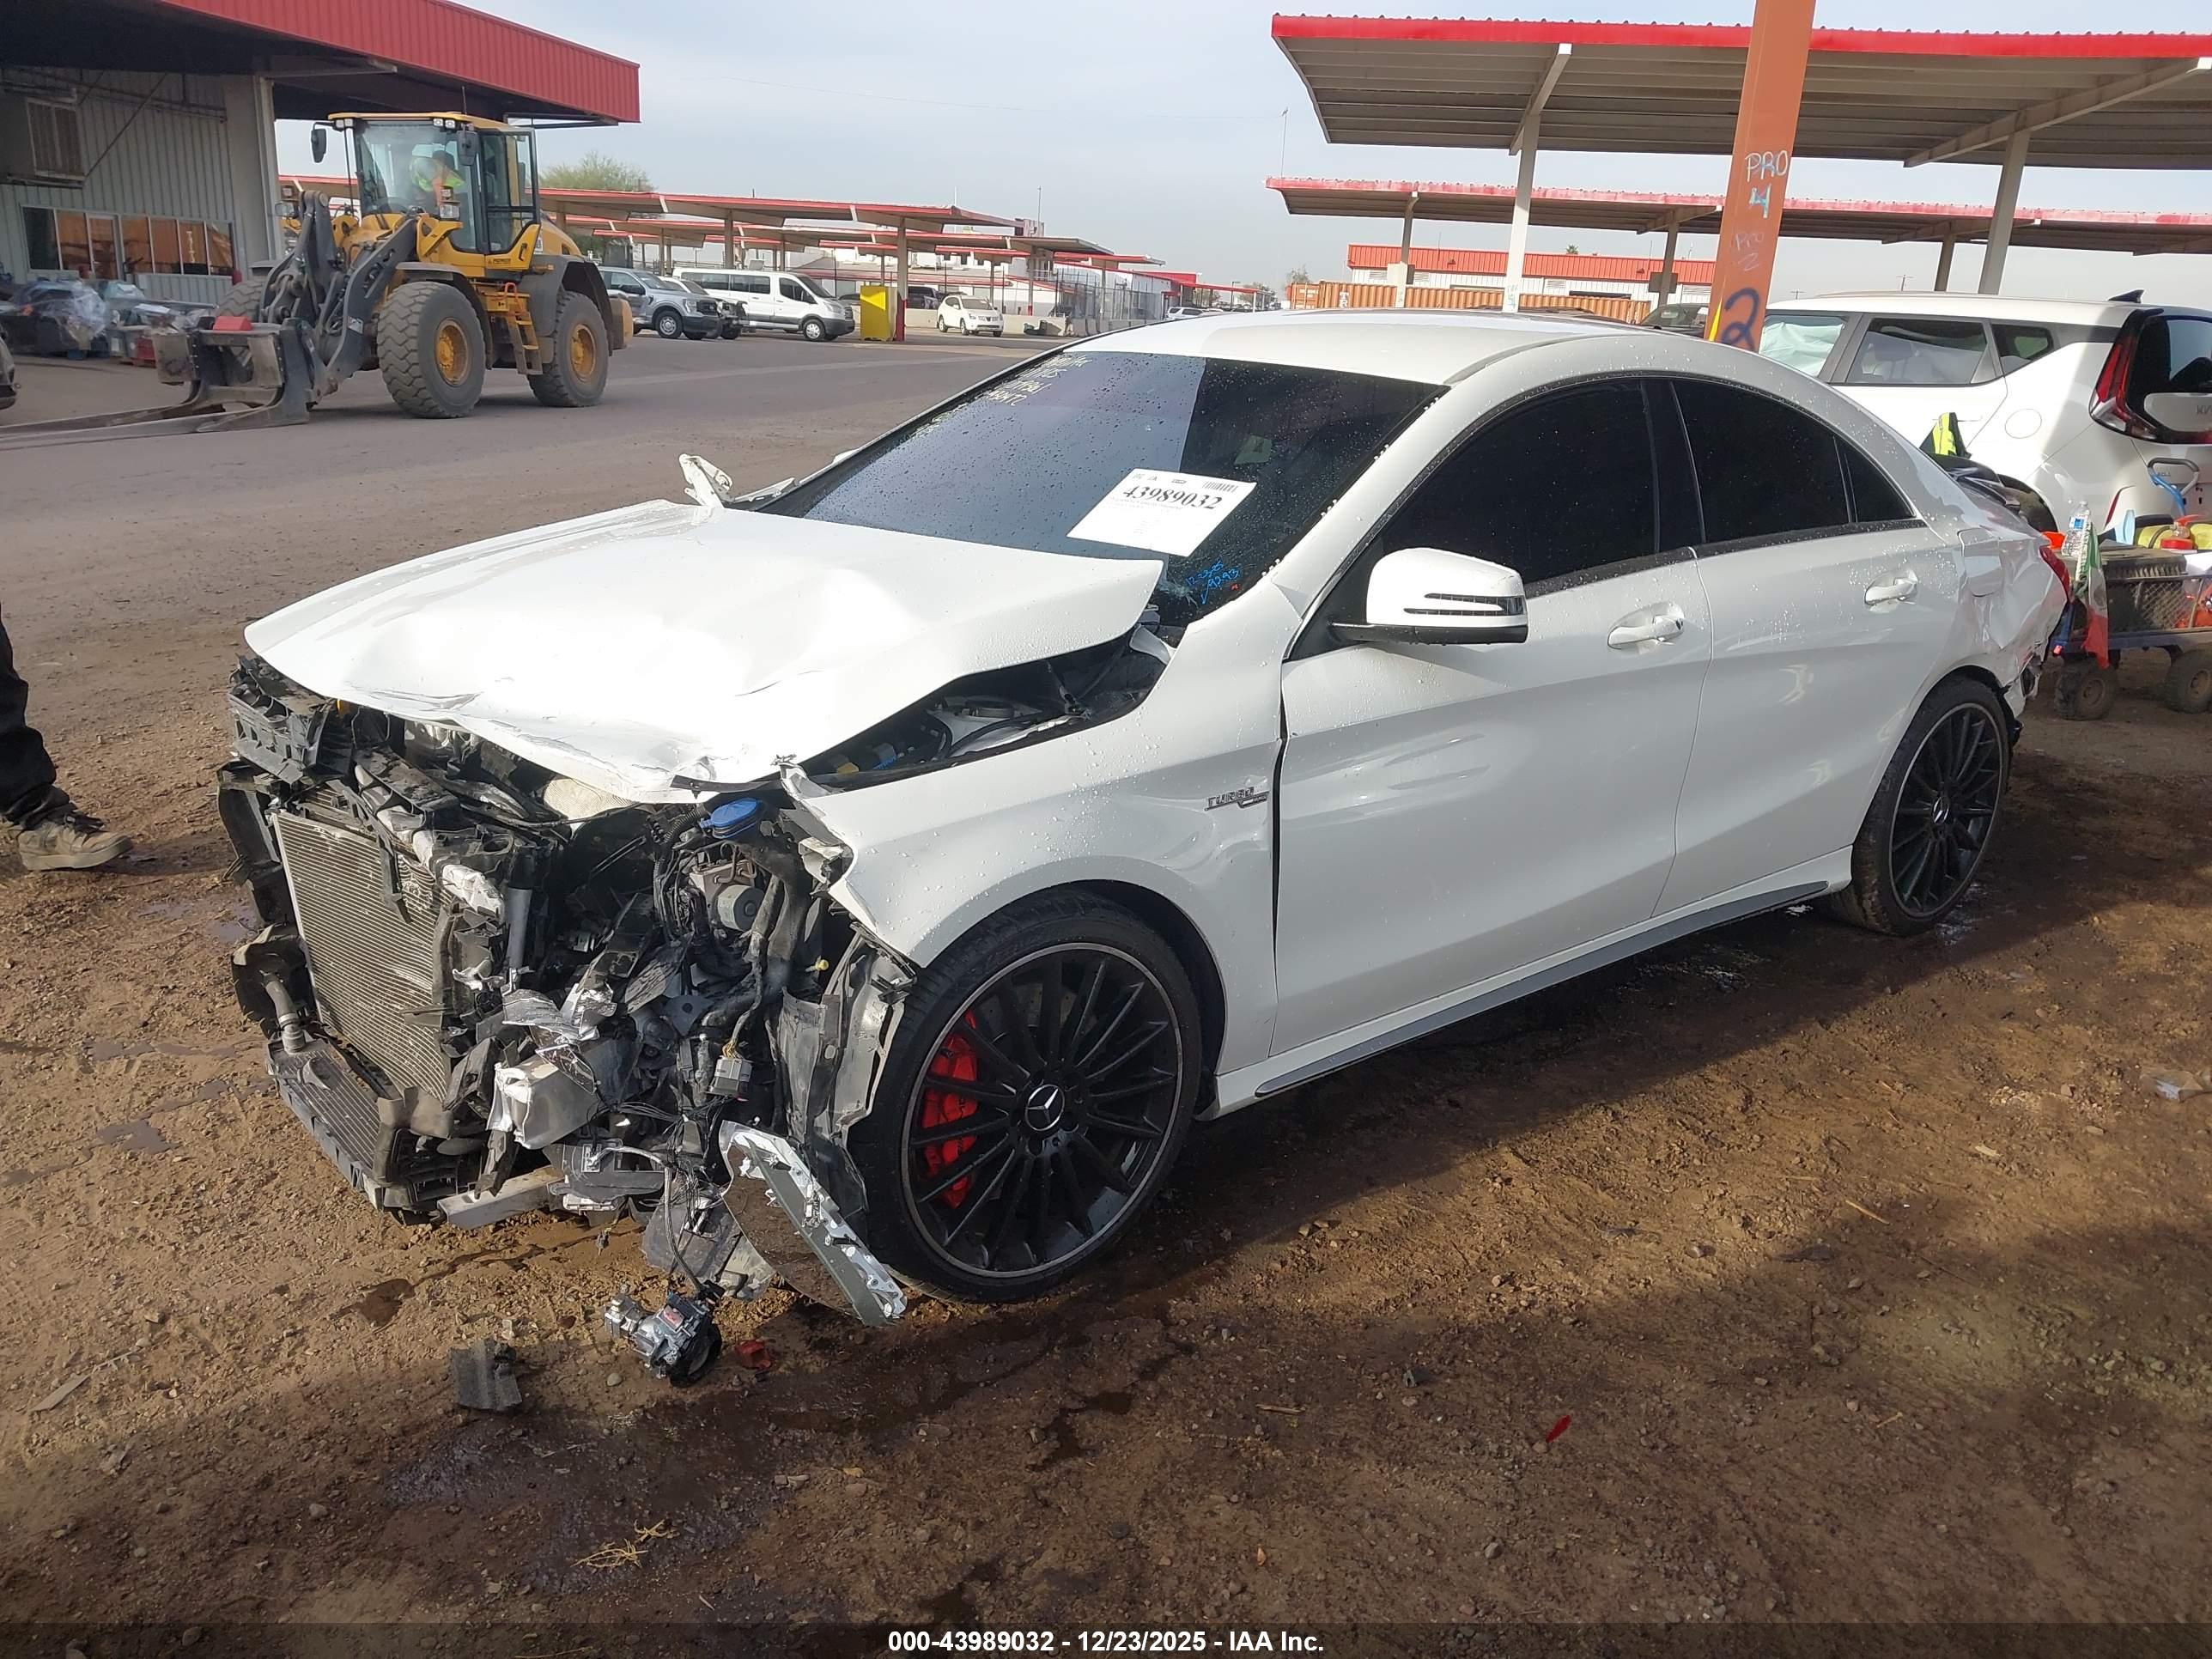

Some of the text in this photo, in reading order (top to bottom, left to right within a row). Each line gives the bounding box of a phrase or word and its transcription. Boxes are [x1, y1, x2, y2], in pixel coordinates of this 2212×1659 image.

[1745, 150, 1789, 182] PRO
[1749, 183, 1771, 218] 4
[1721, 288, 1759, 354] 2
[1123, 485, 1223, 509] 43989032
